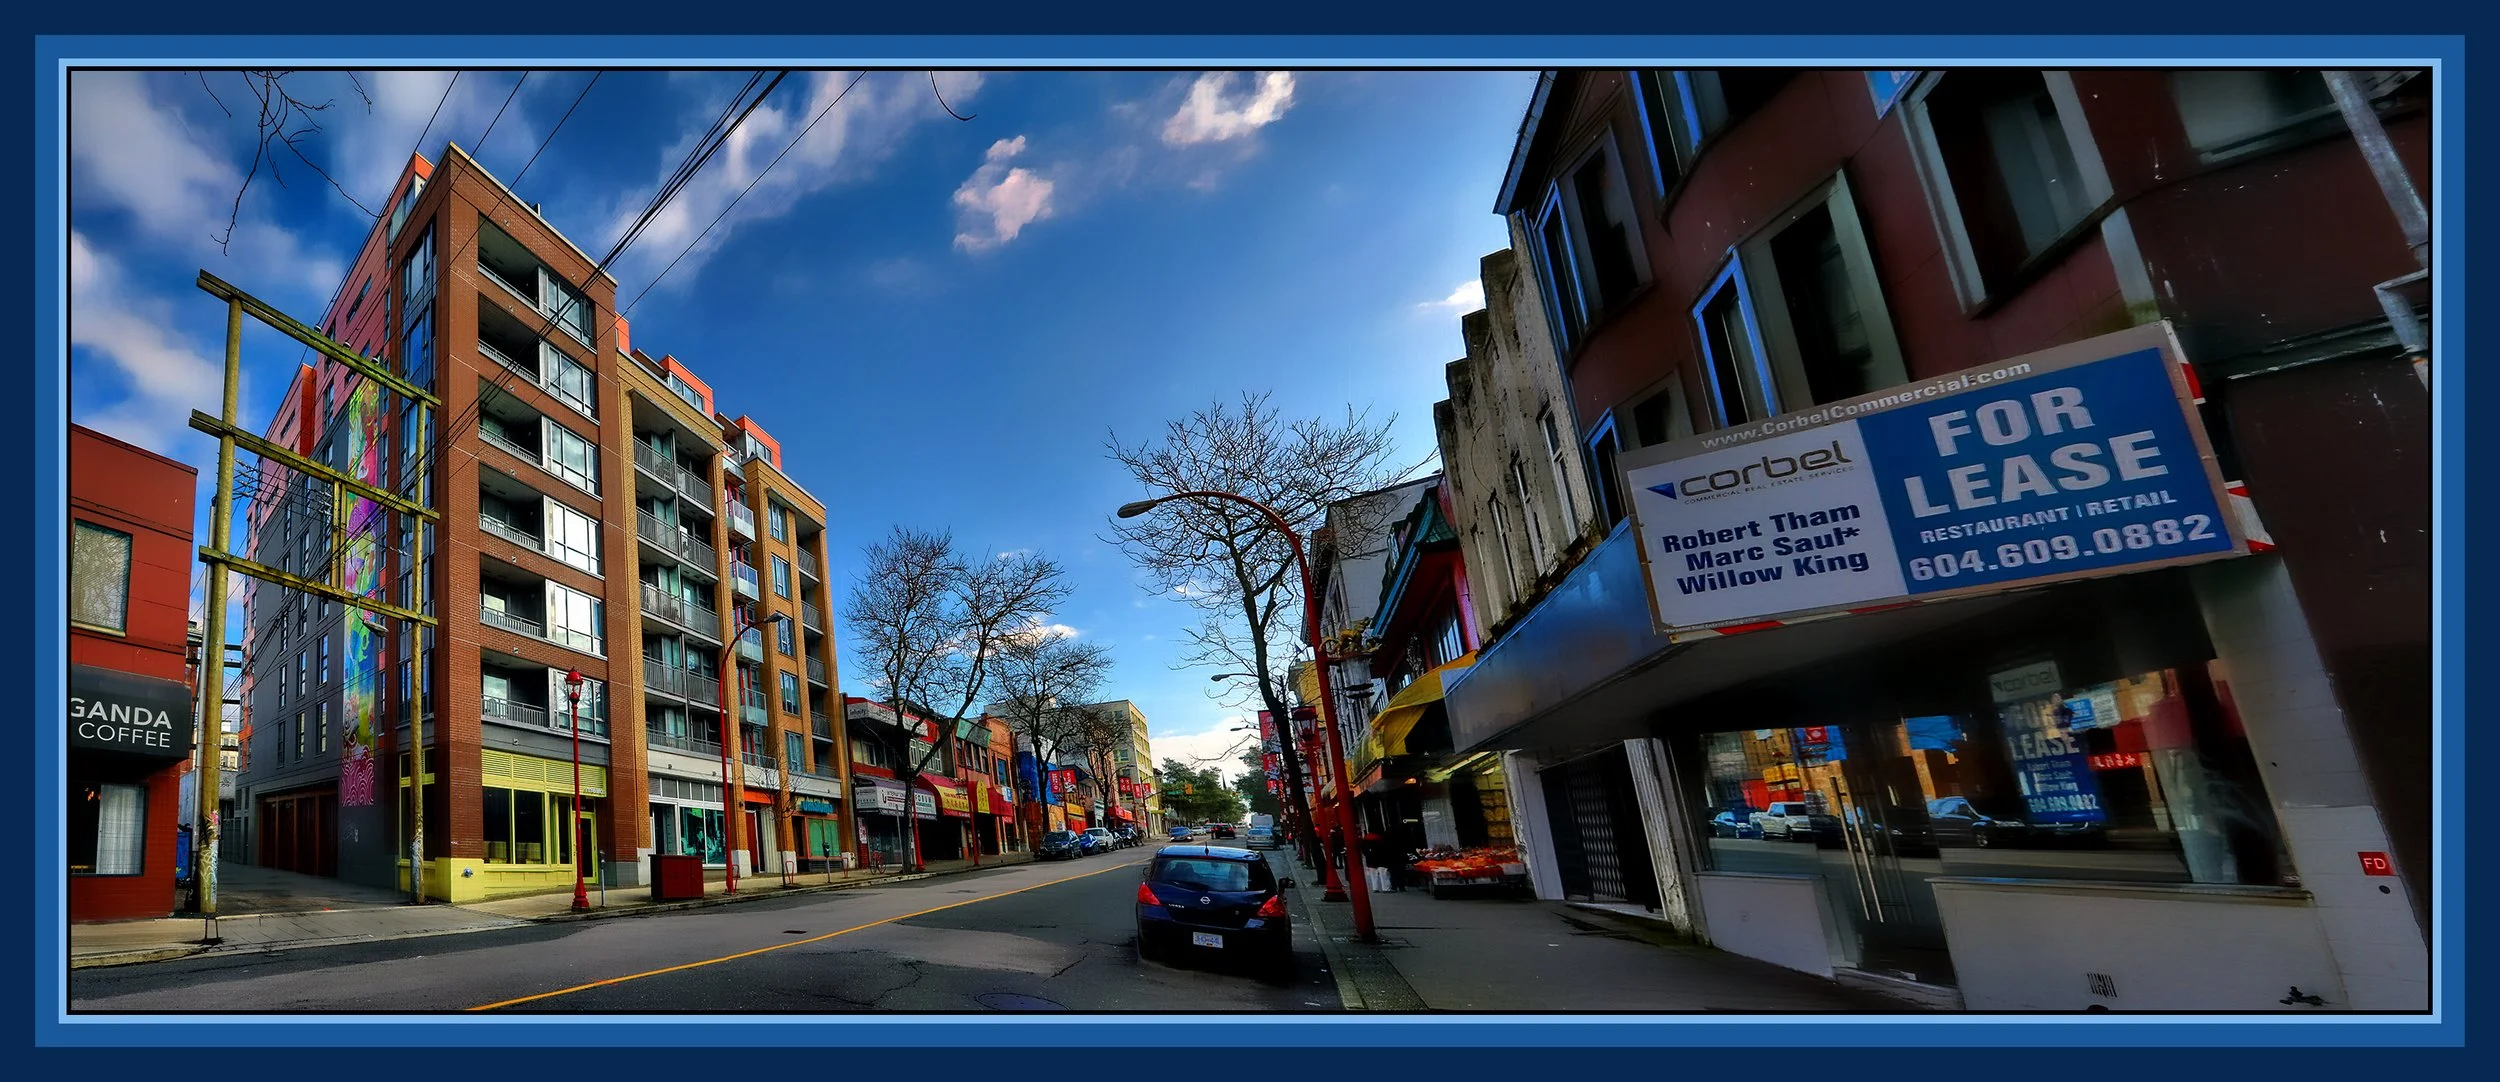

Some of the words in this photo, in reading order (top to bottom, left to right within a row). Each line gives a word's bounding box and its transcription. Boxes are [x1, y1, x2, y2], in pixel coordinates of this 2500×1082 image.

[1702, 361, 2032, 449] www.CorbelCommercial.com
[1928, 386, 2096, 457] FOR
[1680, 440, 1853, 497] corbel
[1683, 489, 1741, 505] COMMERCIAL
[1744, 484, 1767, 493] REAL
[1770, 475, 1805, 488] ESTATE
[1808, 466, 1854, 479] SERVICES
[1903, 430, 2169, 519] LEASE
[1662, 520, 1763, 553] Robert
[1769, 504, 1861, 533] Tham
[1920, 506, 2069, 544] RESTAURANT
[2085, 490, 2178, 517] RETAIL
[1685, 545, 1765, 572] Marc
[1908, 513, 2217, 582] 604.609.0882
[1677, 565, 1783, 595] Willow
[1793, 552, 1870, 577] King
[71, 697, 173, 729] GANDA
[78, 721, 171, 748] COFFEE
[2007, 731, 2080, 761] LEASE
[2363, 857, 2386, 869] FD
